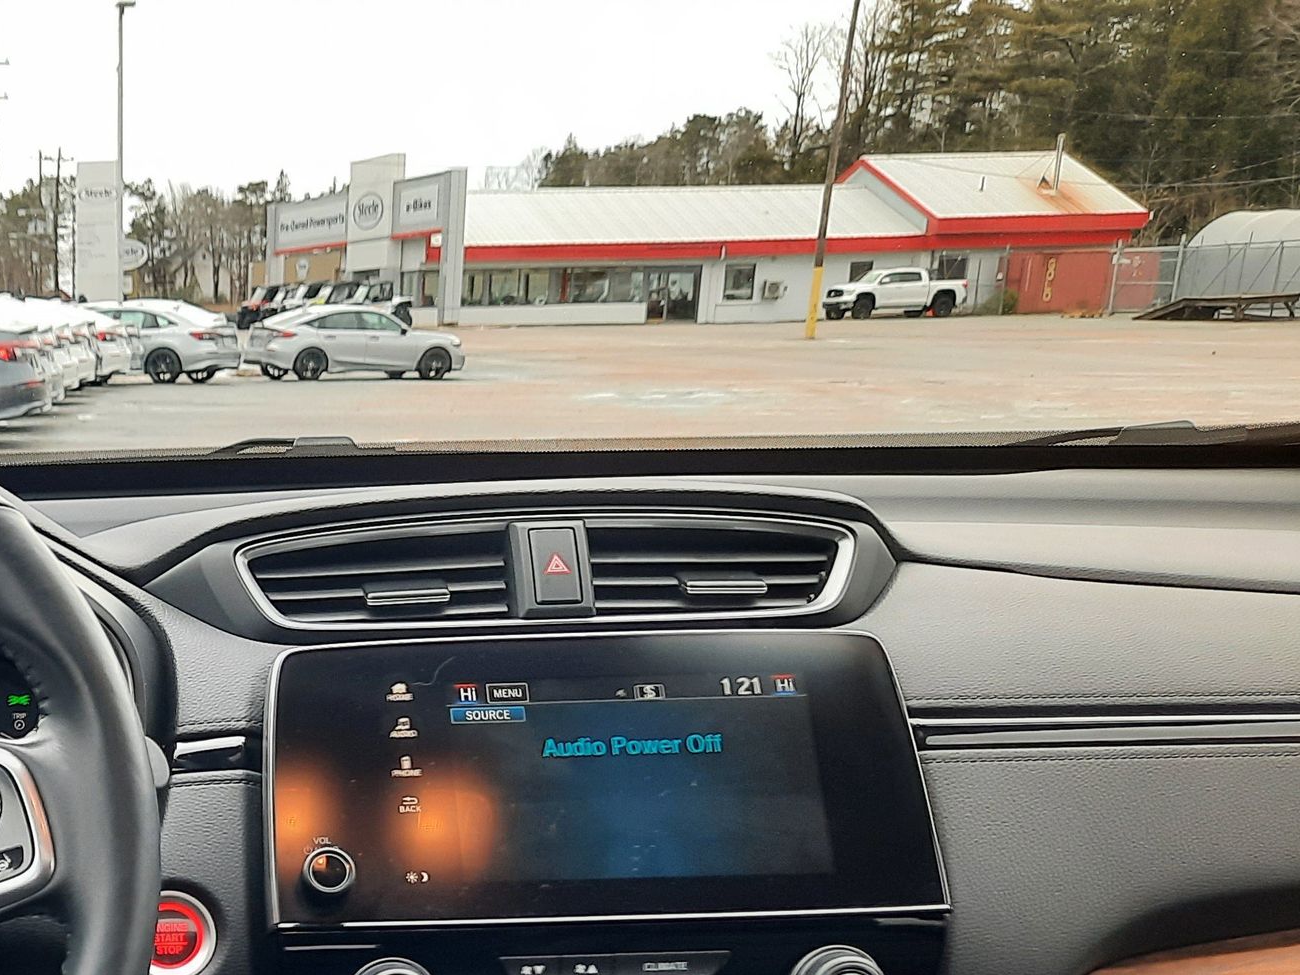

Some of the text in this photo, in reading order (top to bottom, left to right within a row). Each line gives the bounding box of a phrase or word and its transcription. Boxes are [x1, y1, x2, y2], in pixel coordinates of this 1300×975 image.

[460, 687, 477, 702] Hi
[493, 688, 522, 698] MENU
[465, 710, 511, 721] SOURCE
[542, 733, 722, 757] Audio Power Off
[399, 805, 421, 813] BACK
[313, 836, 332, 846] VOL
[157, 923, 188, 932] NGINE
[156, 945, 183, 955] STOP
